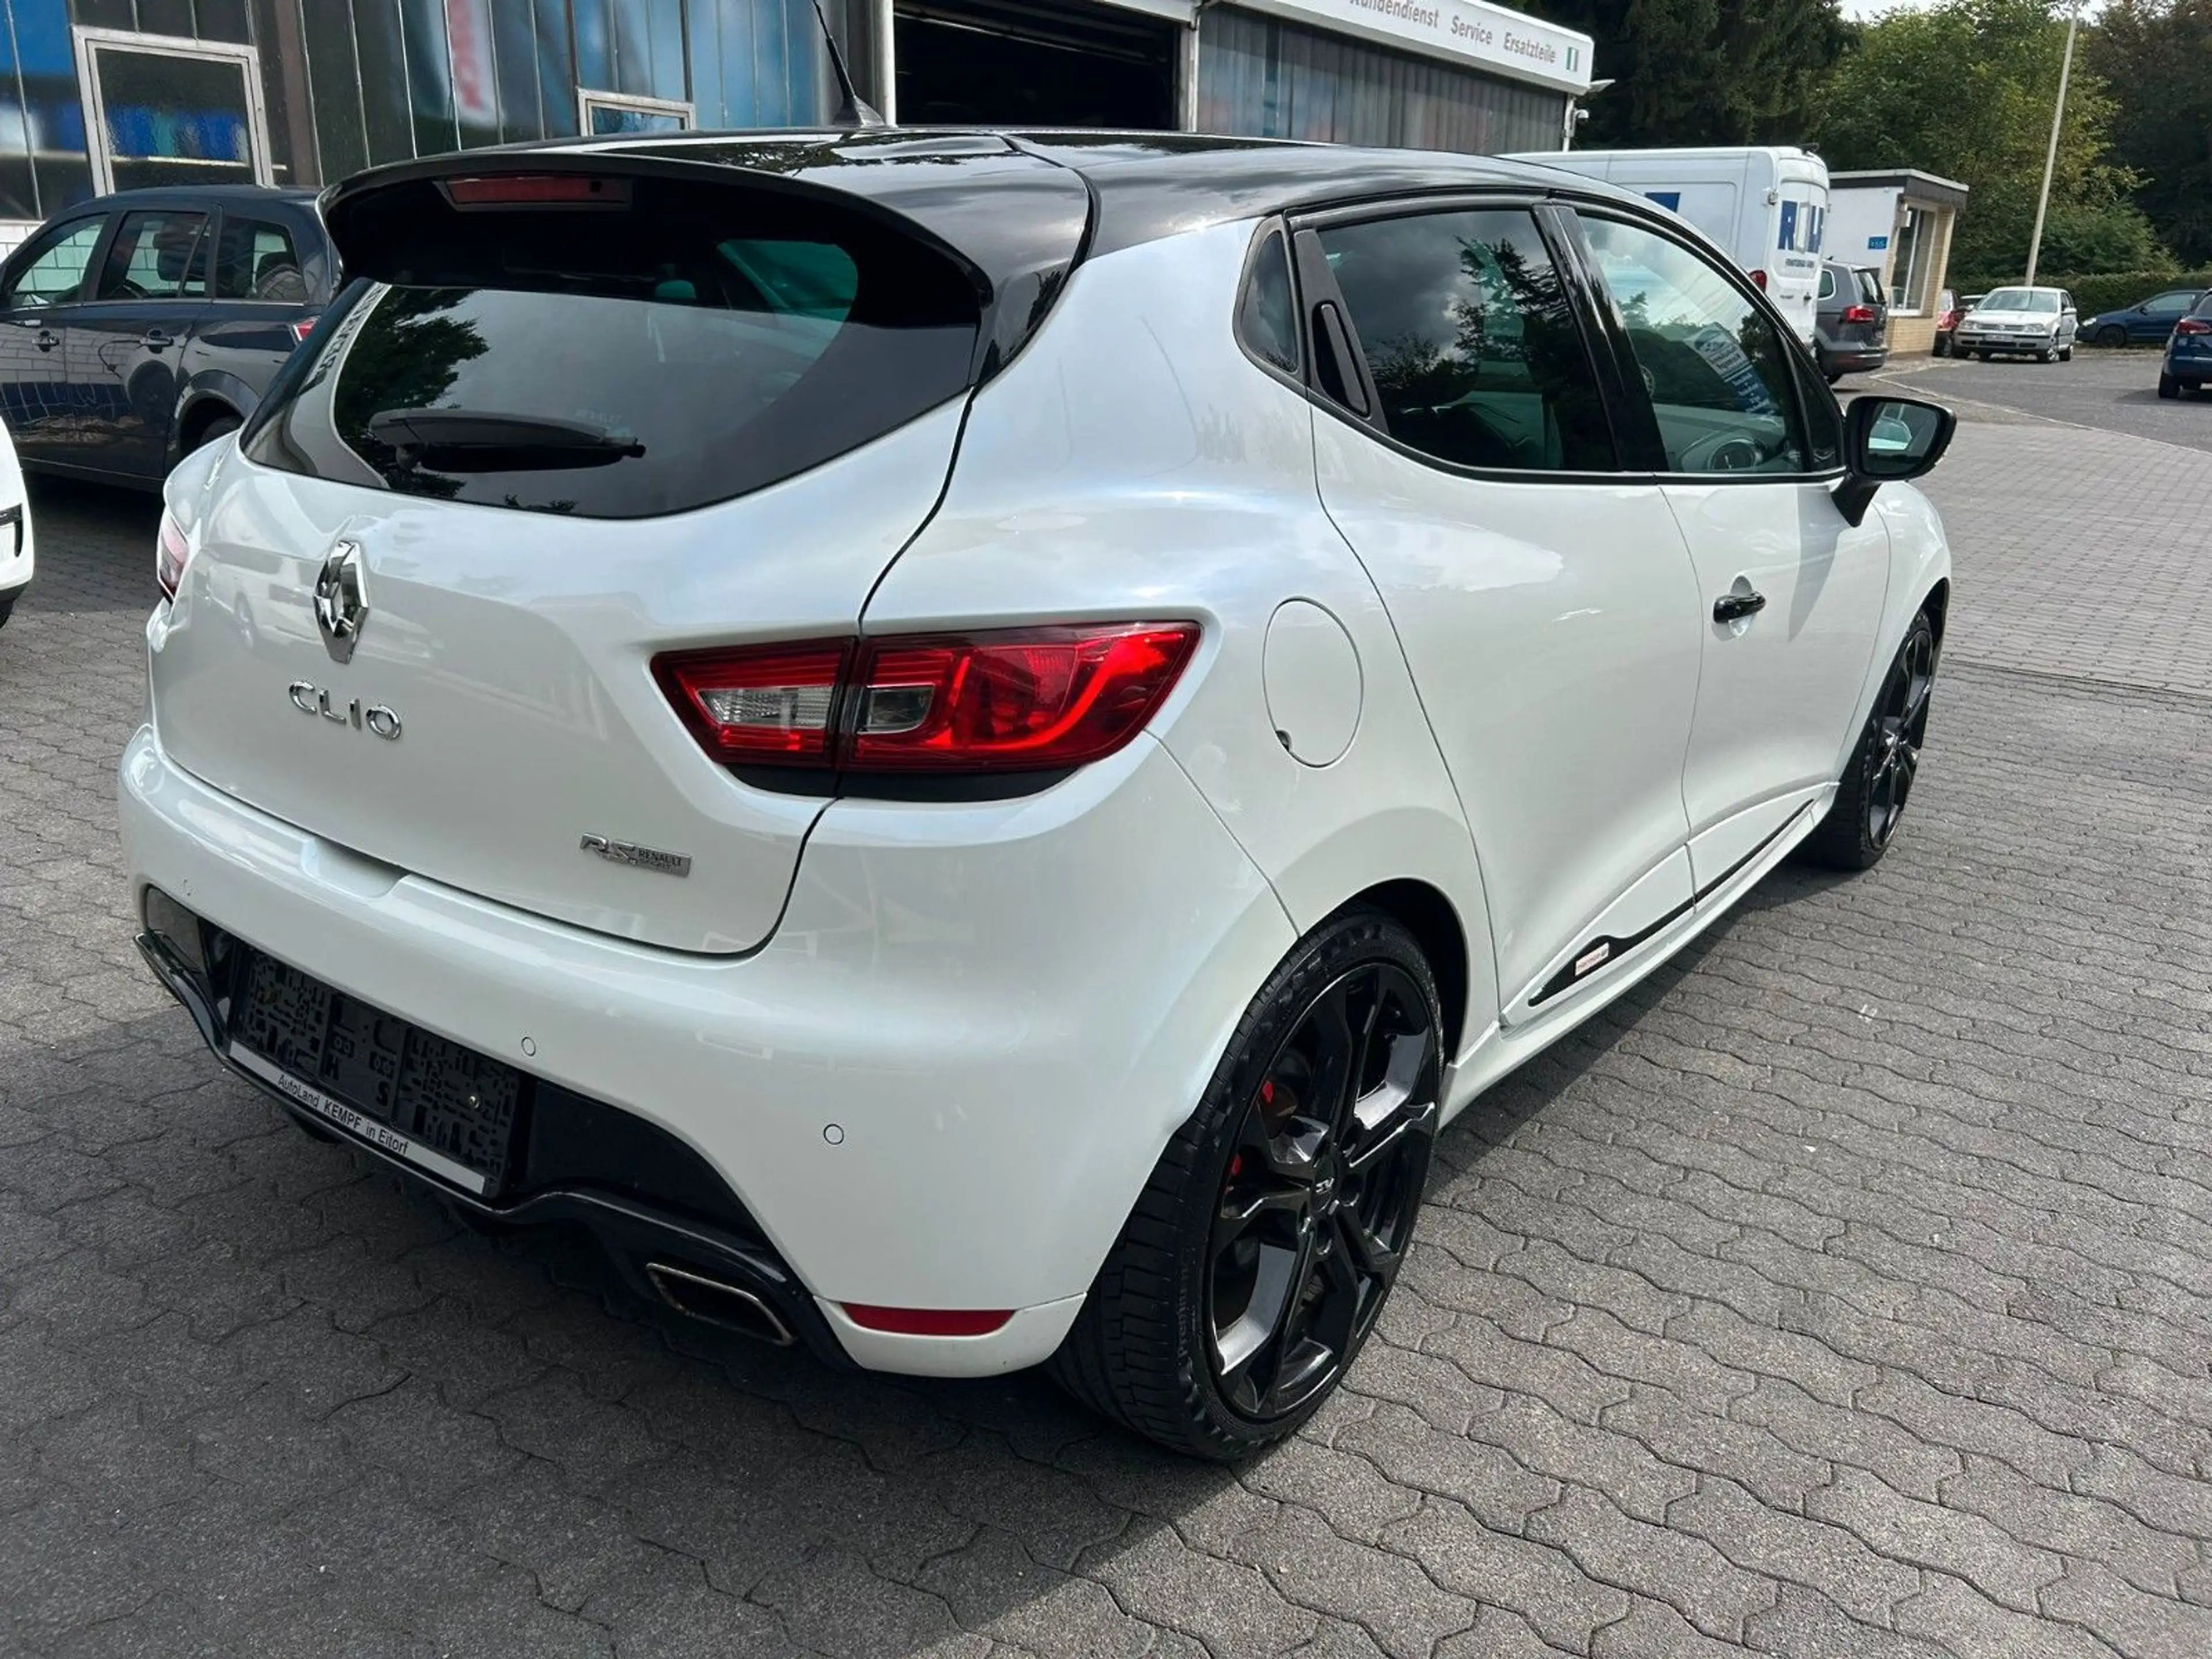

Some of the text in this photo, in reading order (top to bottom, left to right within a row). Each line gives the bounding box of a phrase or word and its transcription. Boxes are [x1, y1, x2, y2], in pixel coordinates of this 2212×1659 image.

[1450, 15, 1493, 44] Service
[1503, 32, 1557, 63] Ersatzteile
[289, 680, 403, 741] CLIO
[278, 1074, 408, 1154] AutoLand KEMPF in Eitorf
